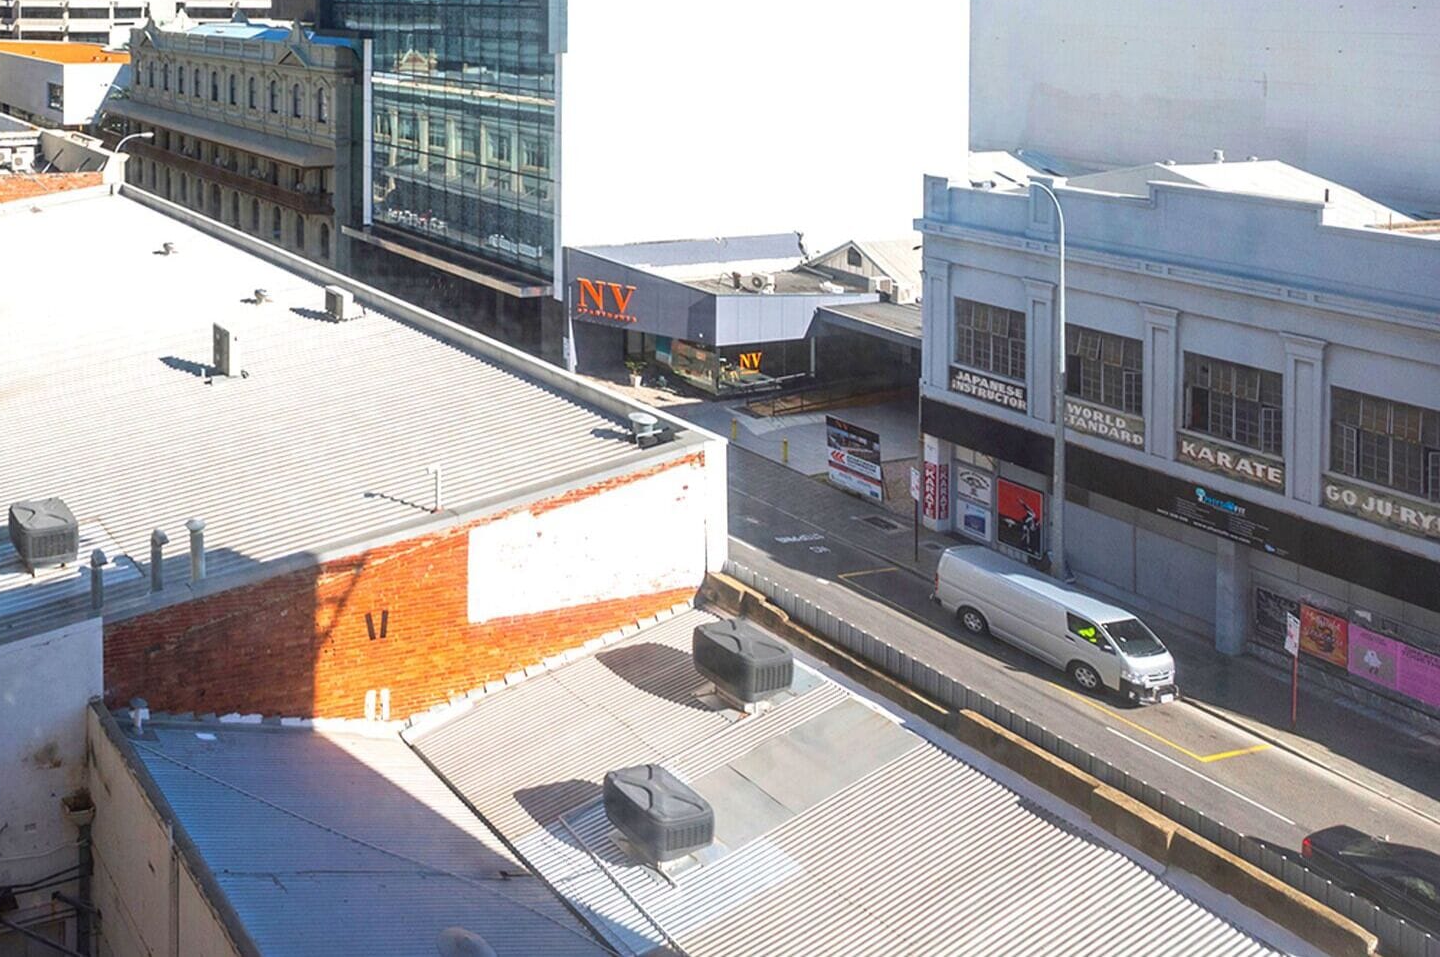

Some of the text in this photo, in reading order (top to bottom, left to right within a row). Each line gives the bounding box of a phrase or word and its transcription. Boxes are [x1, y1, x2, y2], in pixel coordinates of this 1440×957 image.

[577, 277, 637, 313] NV
[740, 352, 762, 370] NV
[955, 371, 1024, 398] JAPANESE
[1066, 403, 1126, 428] WORLD
[1181, 441, 1283, 484] KARATE
[1326, 485, 1440, 533] GO JU-RY
